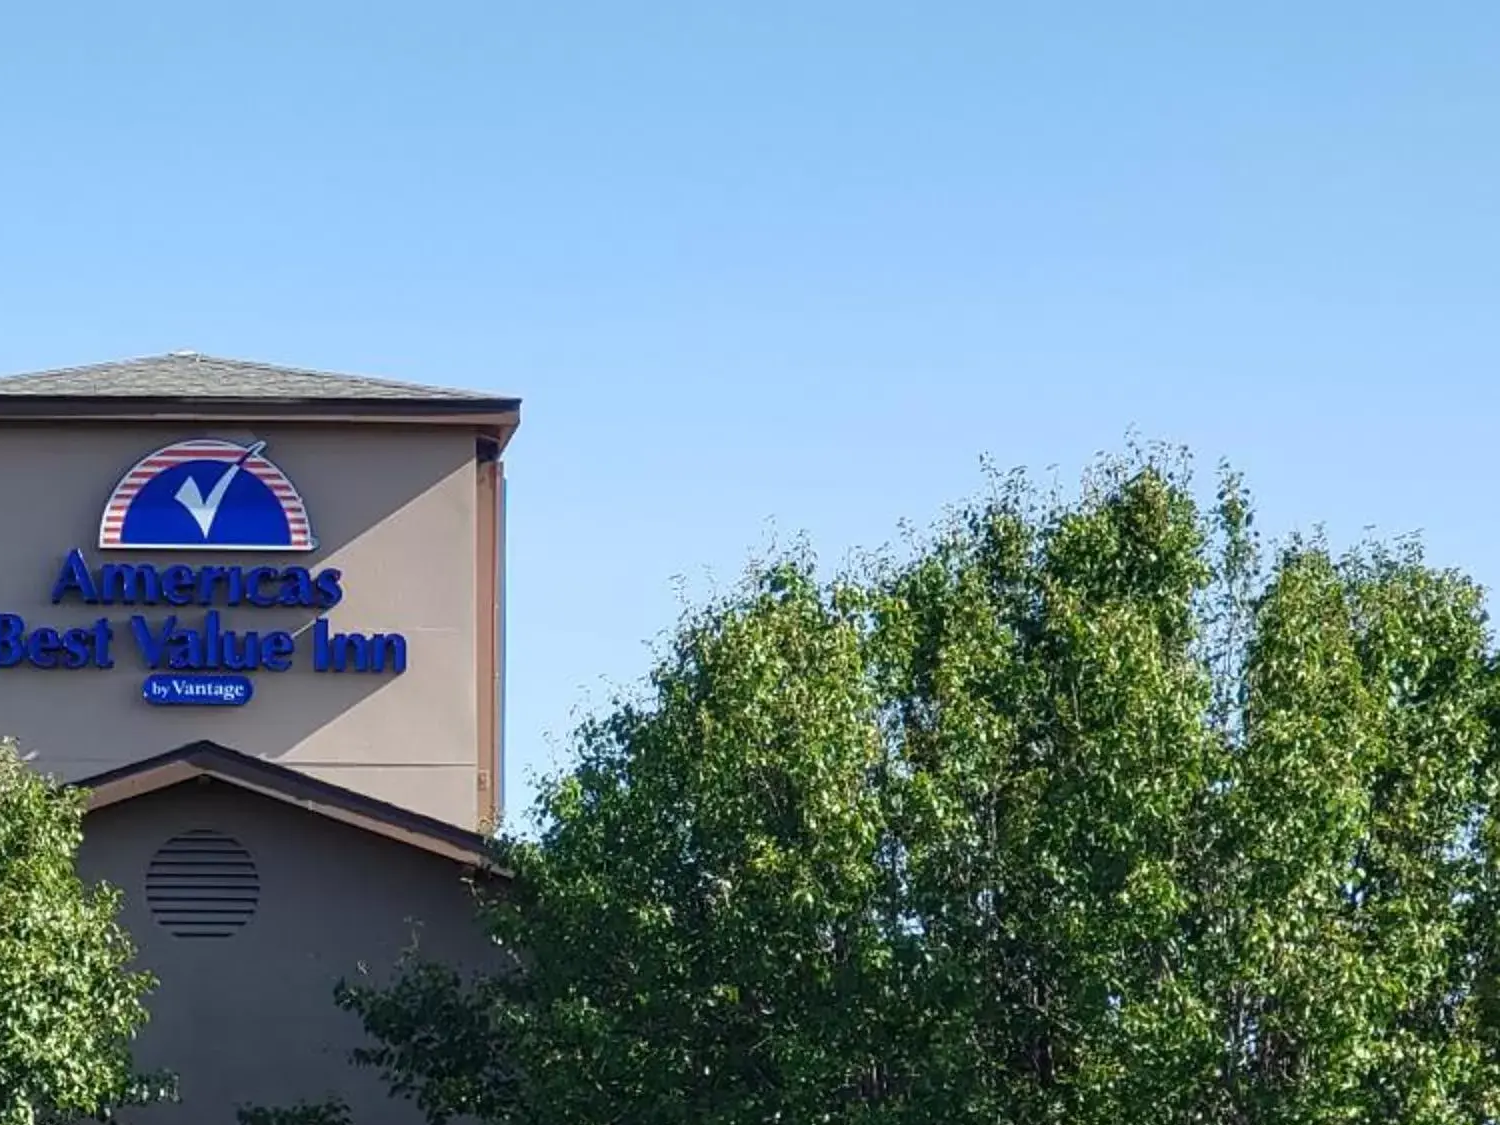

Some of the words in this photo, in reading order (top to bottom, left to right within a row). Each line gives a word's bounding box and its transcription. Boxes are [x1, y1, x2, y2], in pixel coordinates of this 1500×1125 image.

[51, 548, 344, 608] Americas
[131, 610, 293, 671] Value
[312, 617, 408, 674] Inn
[151, 681, 170, 699] by
[172, 680, 245, 701] Vantage
